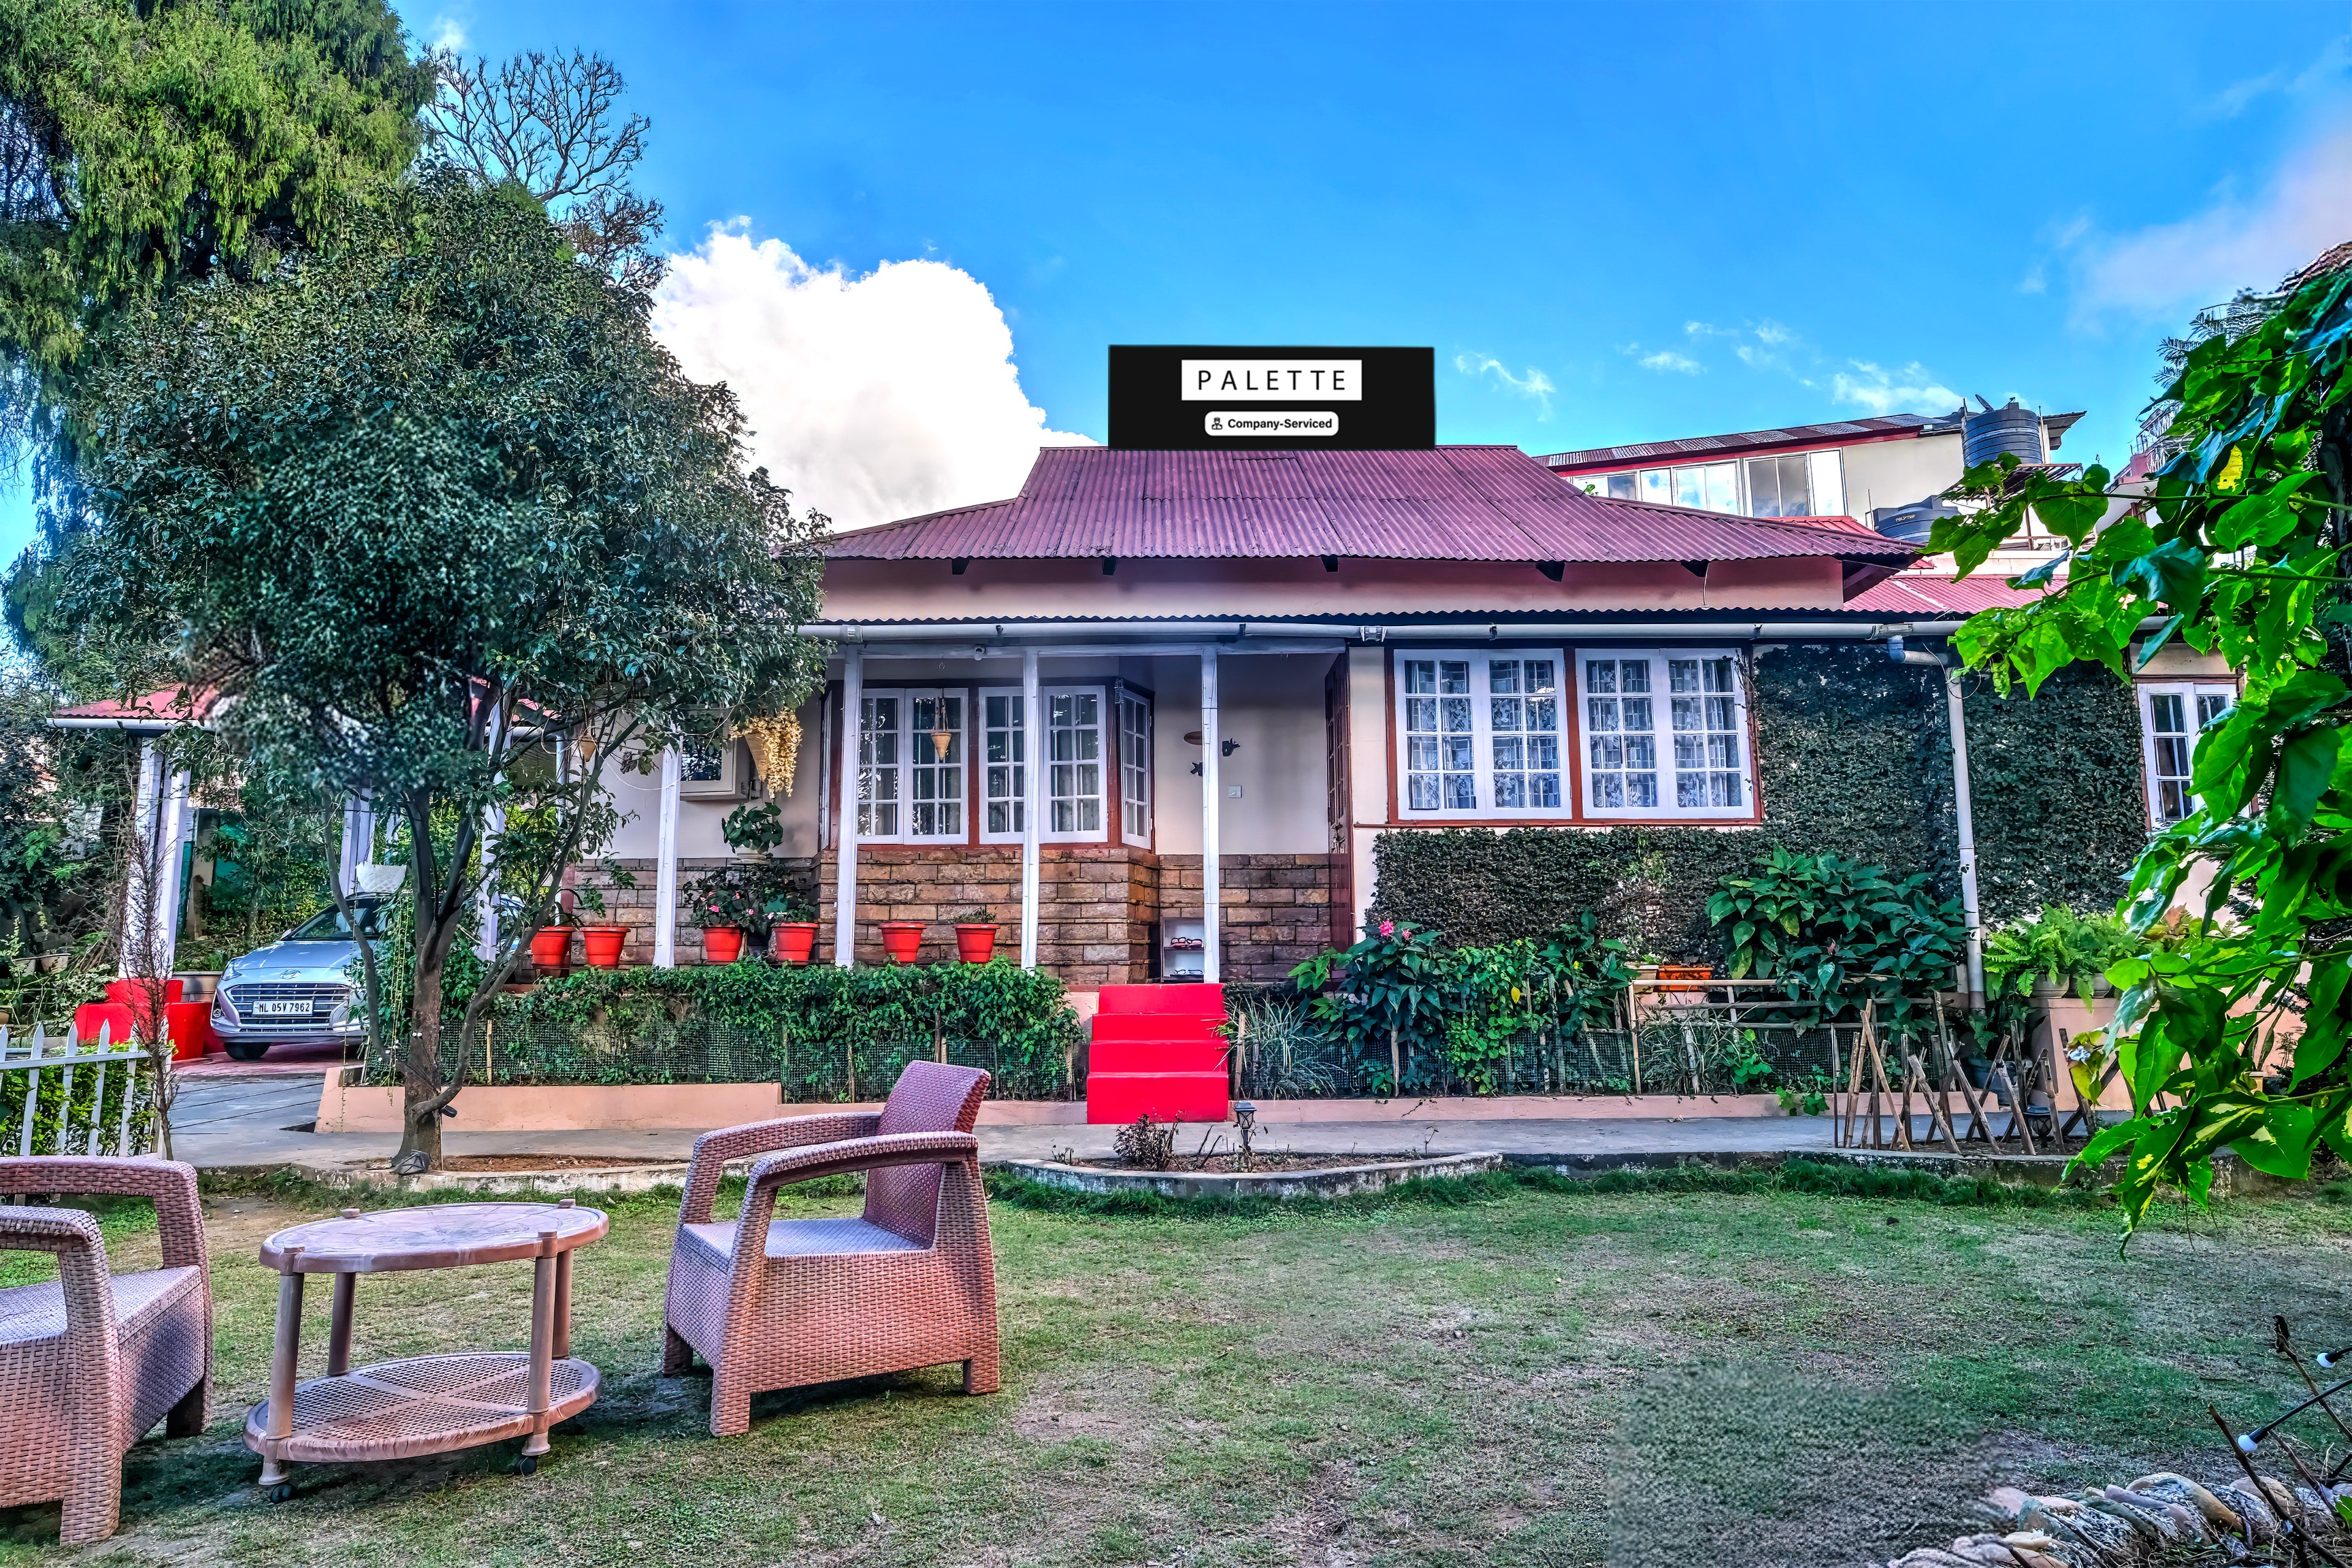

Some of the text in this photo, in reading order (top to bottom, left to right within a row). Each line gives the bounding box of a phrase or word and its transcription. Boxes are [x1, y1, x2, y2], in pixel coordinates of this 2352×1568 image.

[1198, 370, 1345, 391] PALETTE
[1228, 418, 1333, 430] Company-Serviced
[289, 1002, 310, 1013] 7962
